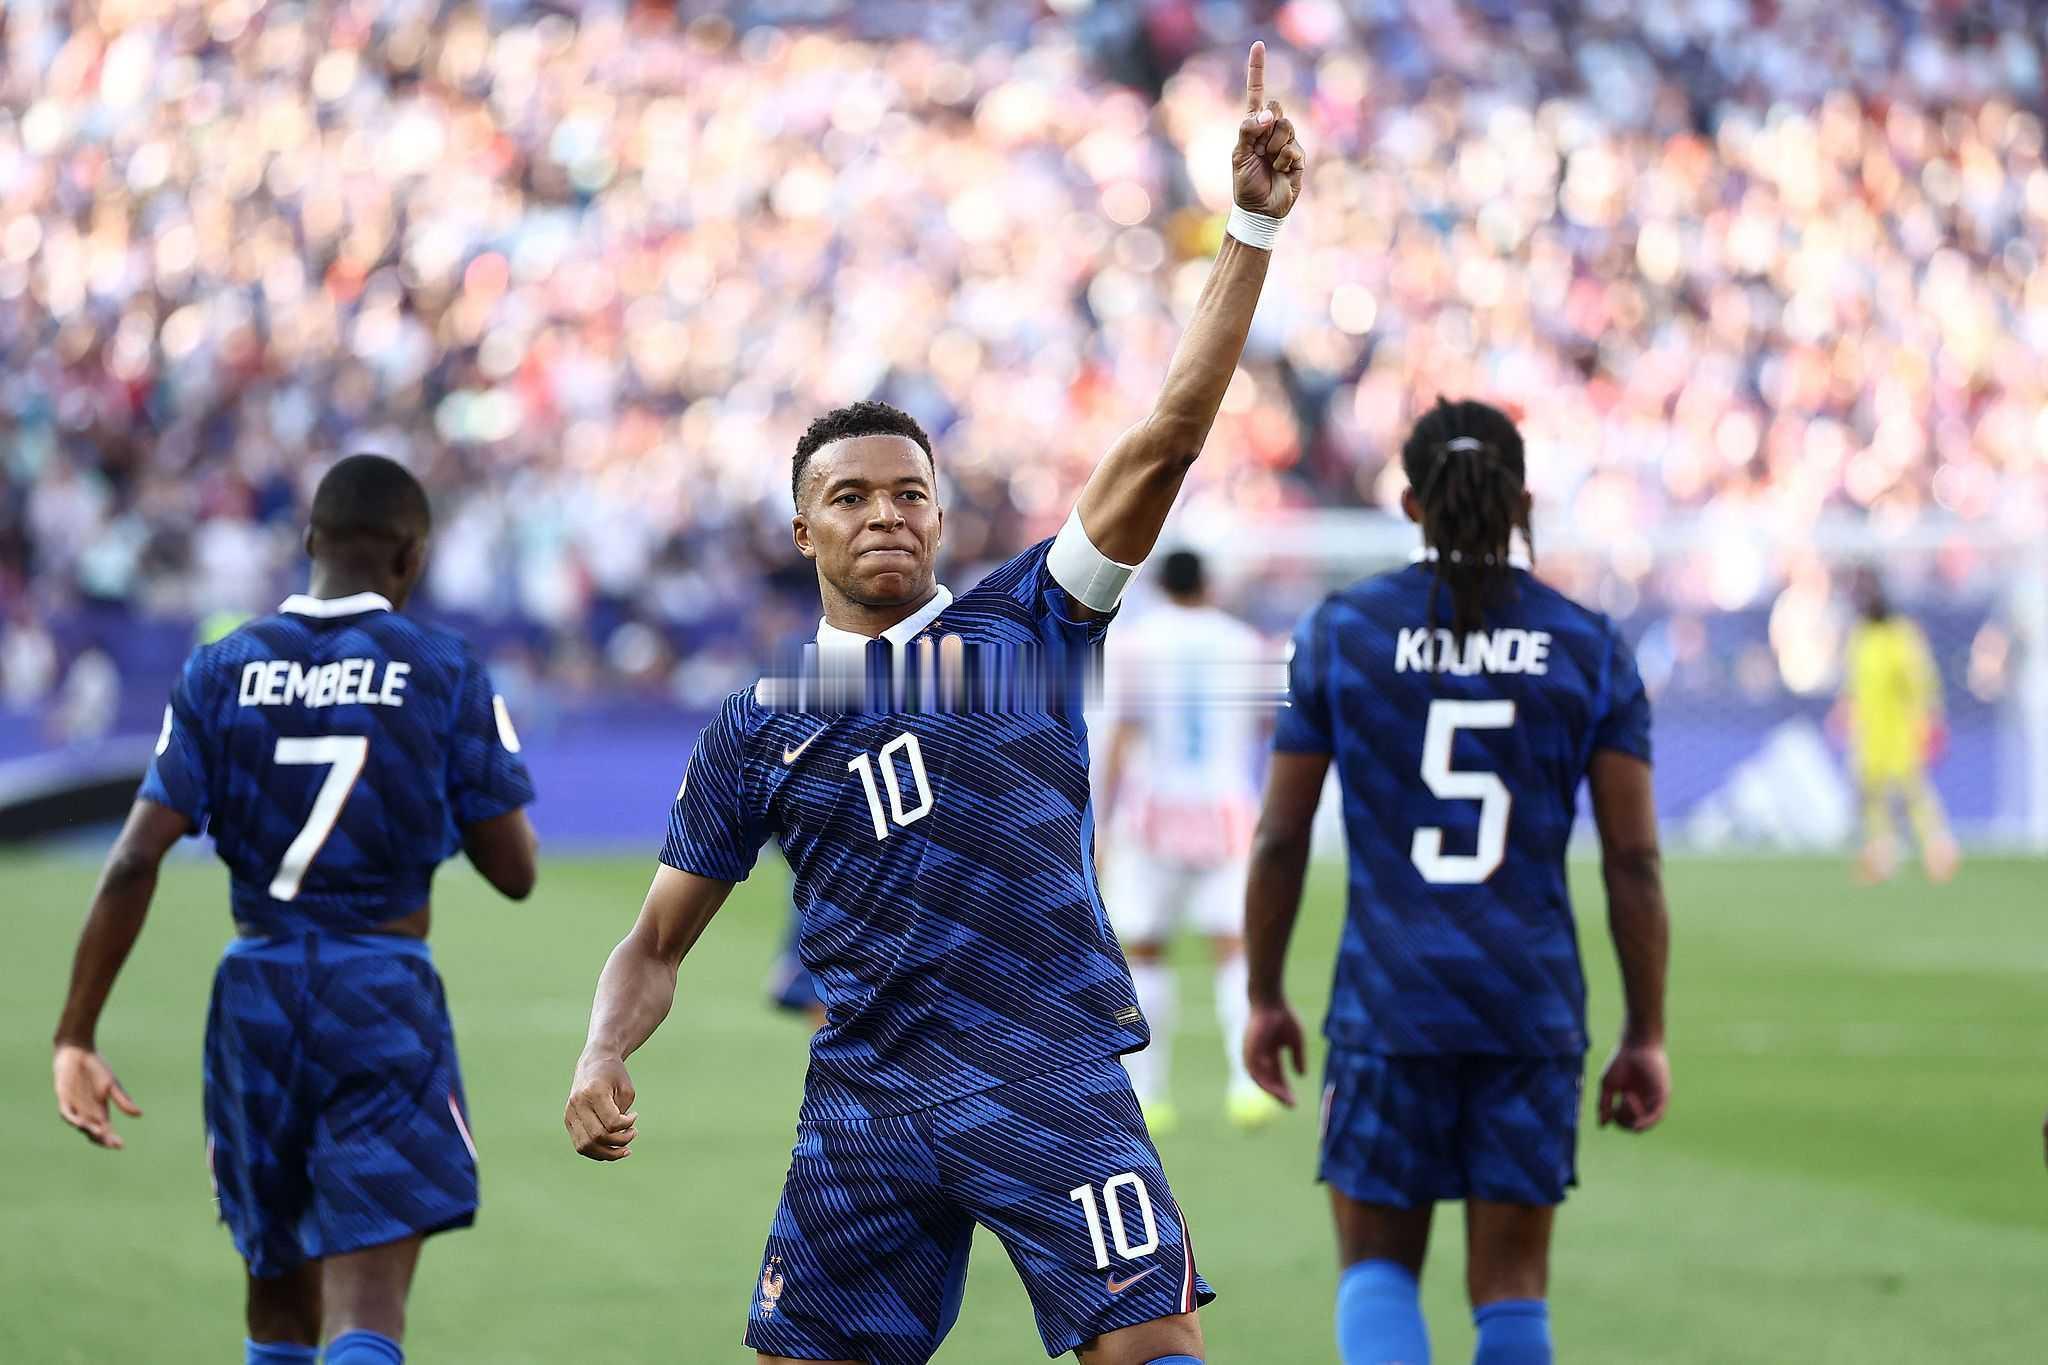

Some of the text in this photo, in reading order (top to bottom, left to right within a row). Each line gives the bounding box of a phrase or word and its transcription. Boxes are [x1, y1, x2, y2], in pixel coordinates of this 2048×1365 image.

[238, 658, 411, 708] DEMBELE
[1394, 627, 1552, 676] KOUNDE
[268, 736, 368, 901] 7
[847, 732, 934, 841] 10
[1410, 700, 1515, 884] 5
[1070, 1171, 1160, 1270] 10
